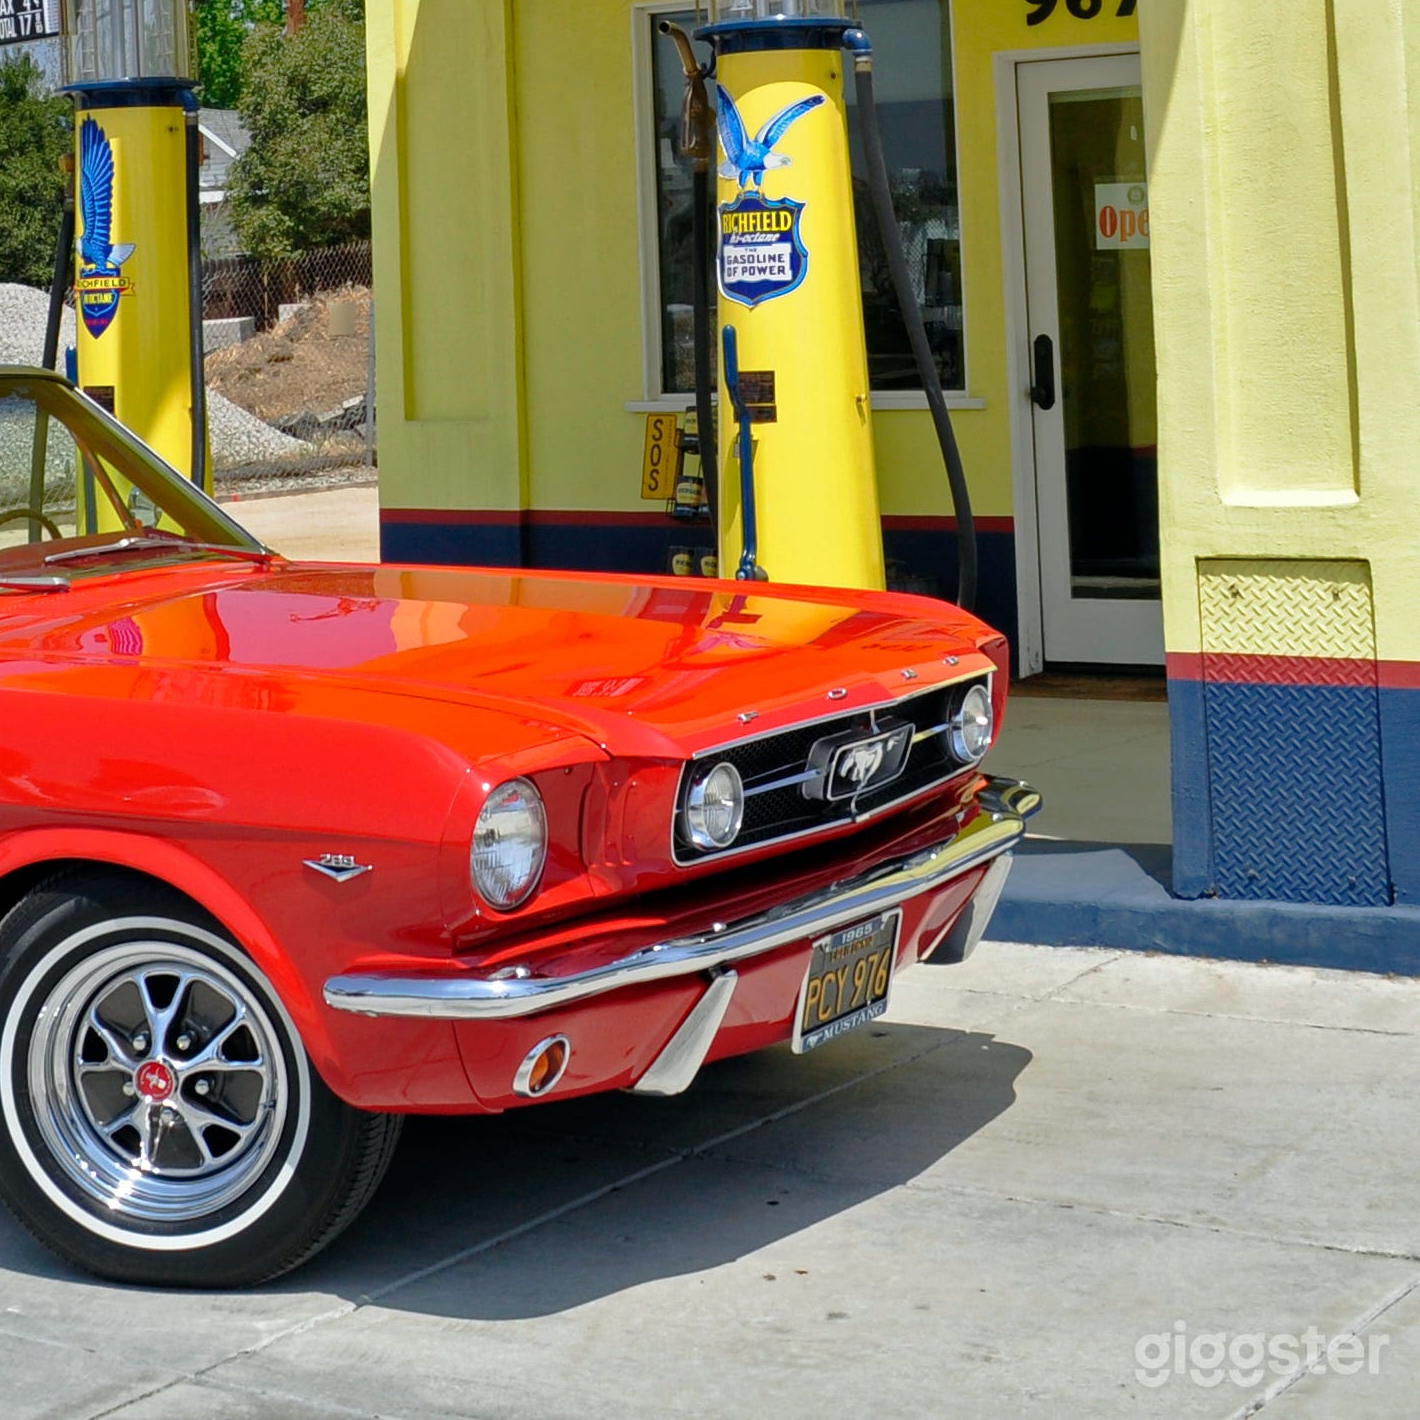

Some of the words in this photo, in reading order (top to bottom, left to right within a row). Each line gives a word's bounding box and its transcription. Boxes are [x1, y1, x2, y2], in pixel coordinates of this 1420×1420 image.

[18, 14, 33, 36] 17
[722, 211, 792, 234] RICHFIELD
[727, 254, 786, 265] GASOLINE
[727, 266, 738, 277] OF
[741, 265, 786, 276] POWER
[803, 964, 849, 1029] PCY
[850, 947, 892, 1008] 976
[823, 1003, 884, 1042] MUSTANG
